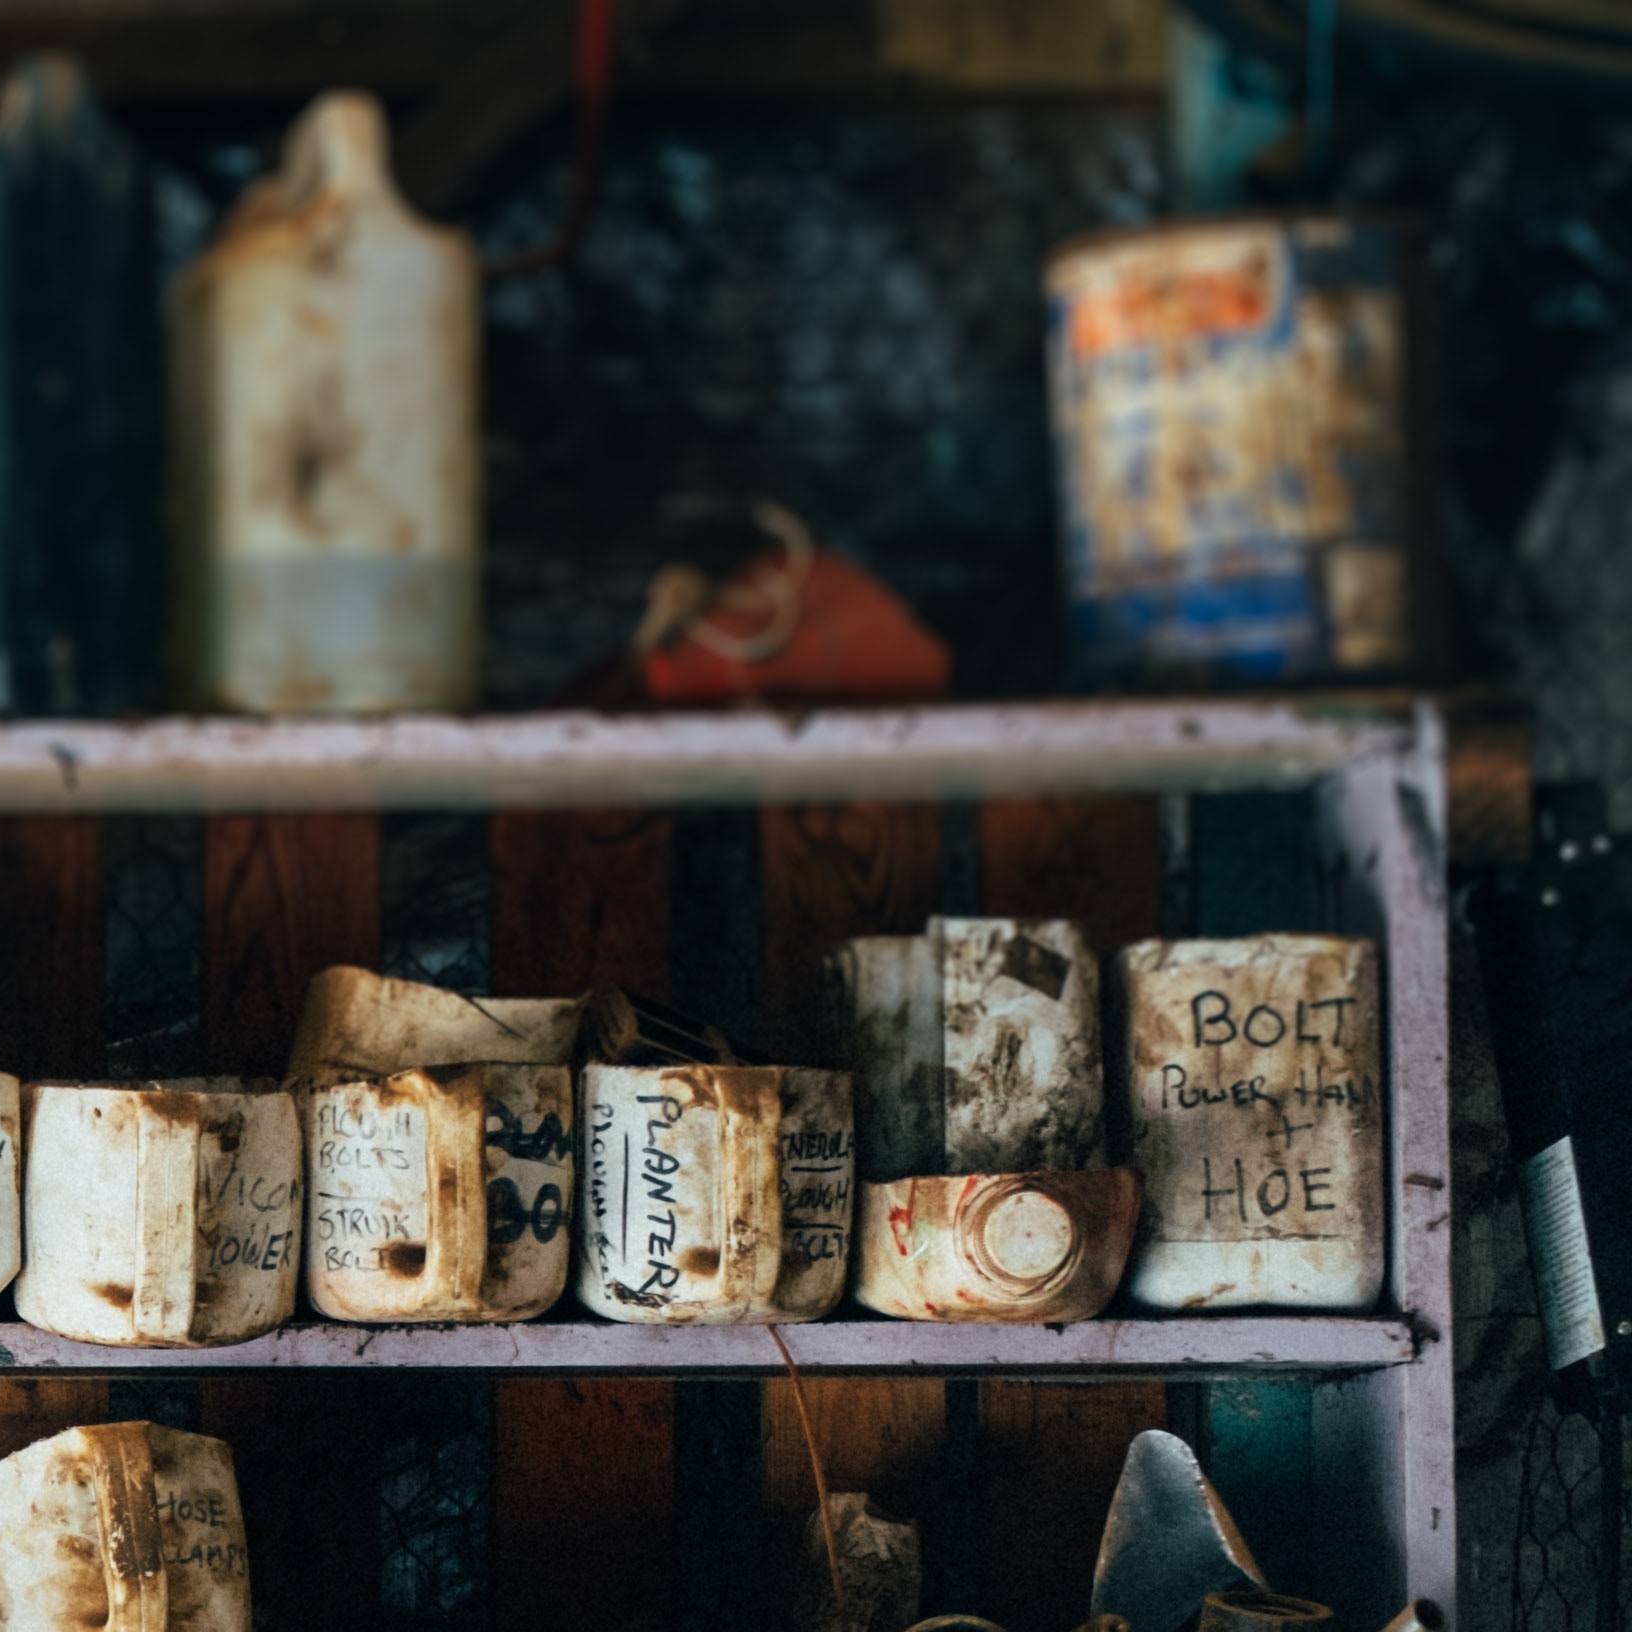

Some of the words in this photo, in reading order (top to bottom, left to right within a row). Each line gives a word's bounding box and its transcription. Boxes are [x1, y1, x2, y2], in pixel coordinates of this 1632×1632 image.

[1190, 990, 1356, 1049] BOLT
[1161, 1063, 1279, 1111] POWER
[636, 1094, 683, 1296] PLANTER
[1200, 1156, 1337, 1223] HOE
